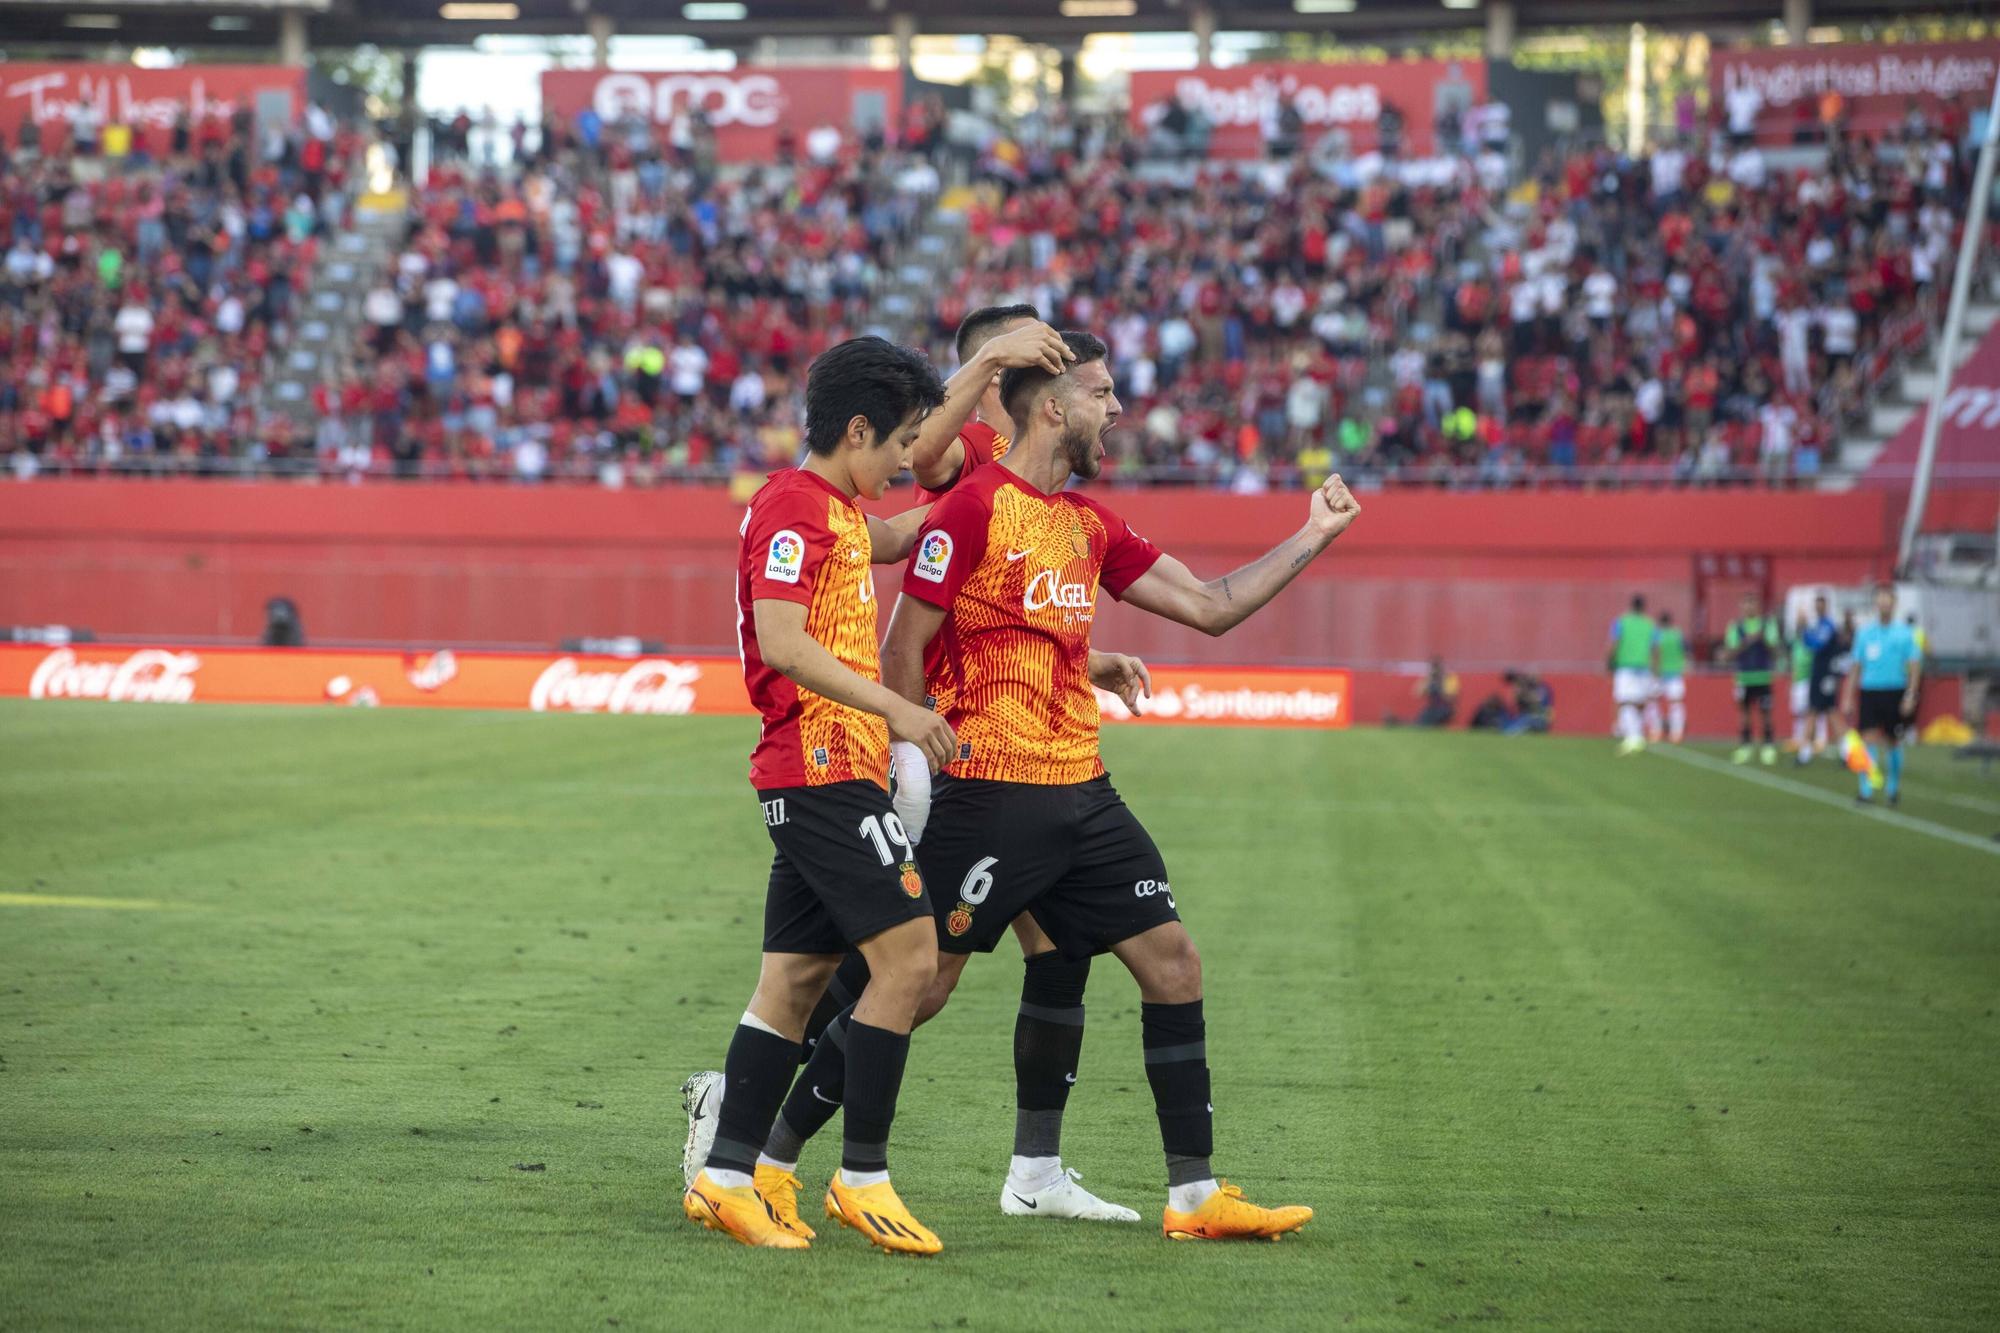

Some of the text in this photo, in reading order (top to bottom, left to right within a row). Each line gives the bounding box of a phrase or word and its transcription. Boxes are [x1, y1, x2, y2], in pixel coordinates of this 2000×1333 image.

[768, 564, 797, 577] LaLiga
[917, 562, 943, 577] LaLiga
[858, 812, 914, 866] 19
[960, 856, 999, 905] 6
